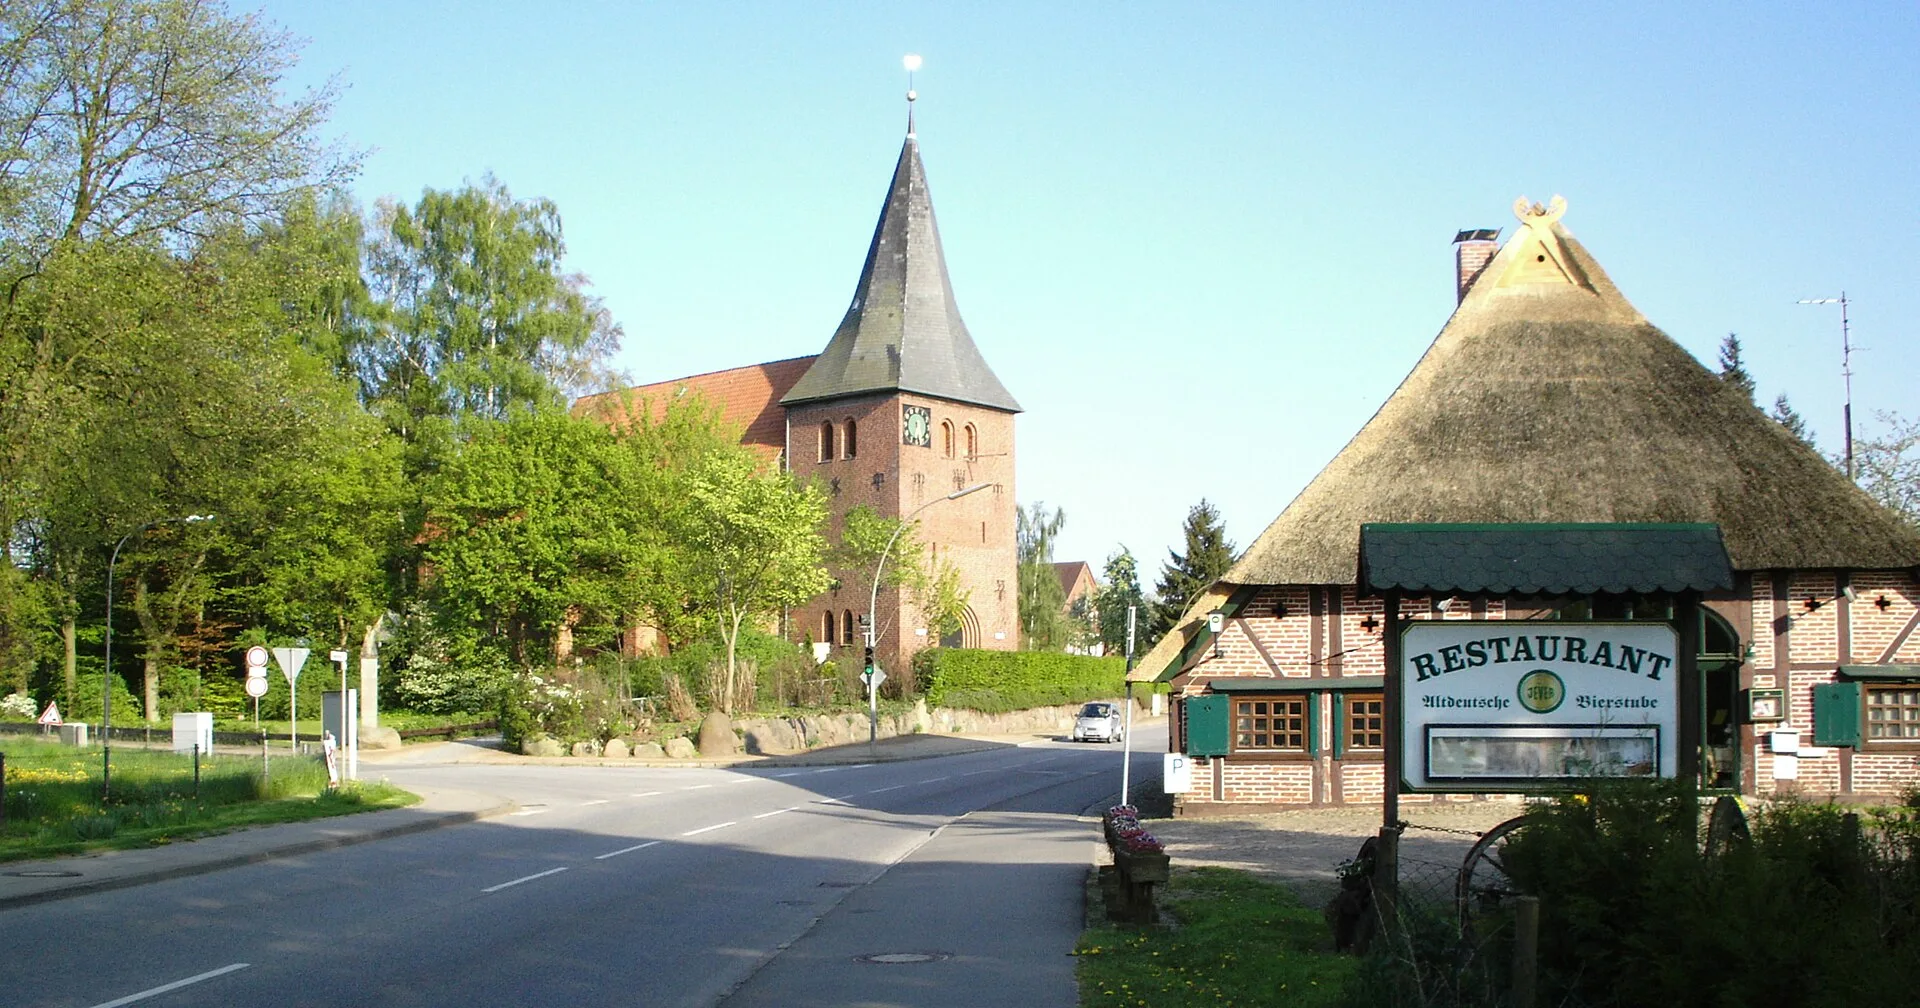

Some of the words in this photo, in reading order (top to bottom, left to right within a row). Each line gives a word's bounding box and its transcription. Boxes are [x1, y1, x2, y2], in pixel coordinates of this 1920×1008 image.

[1410, 635, 1672, 682] RESTAURANT
[1422, 695, 1510, 710] Altdeutsche
[1576, 695, 1658, 708] Bierstube
[1173, 758, 1183, 774] P
